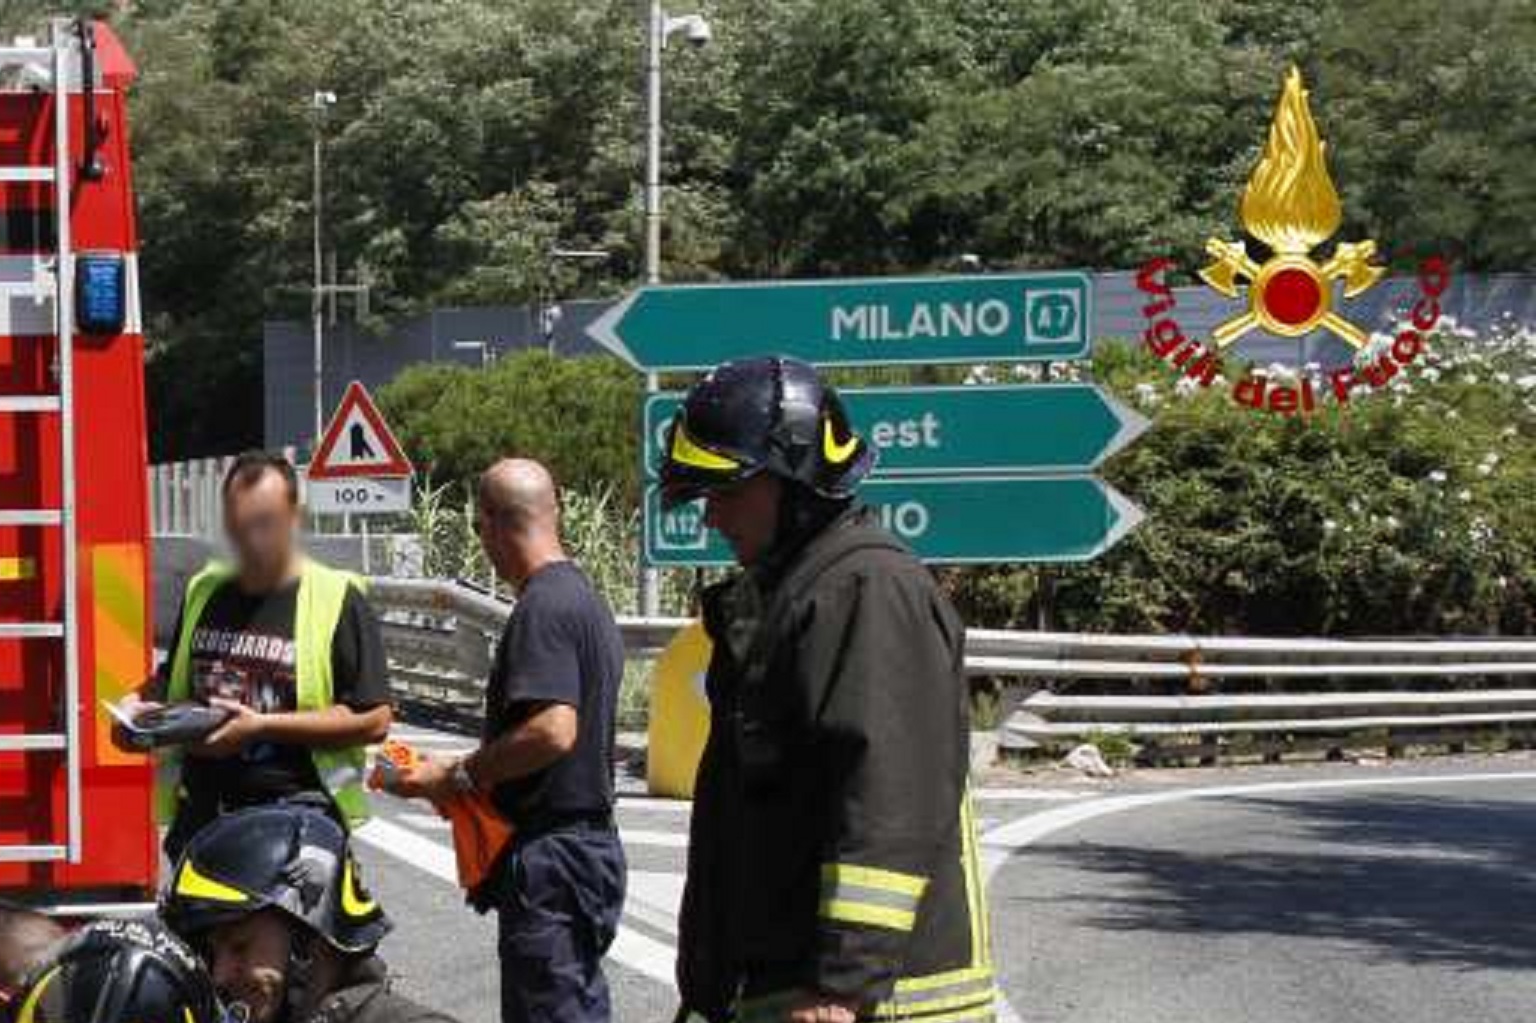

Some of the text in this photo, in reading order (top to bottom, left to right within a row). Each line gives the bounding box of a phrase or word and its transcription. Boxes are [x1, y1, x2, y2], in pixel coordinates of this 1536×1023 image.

[831, 299, 1070, 341] MILANO A7
[871, 411, 942, 448] est
[335, 487, 369, 504] 100
